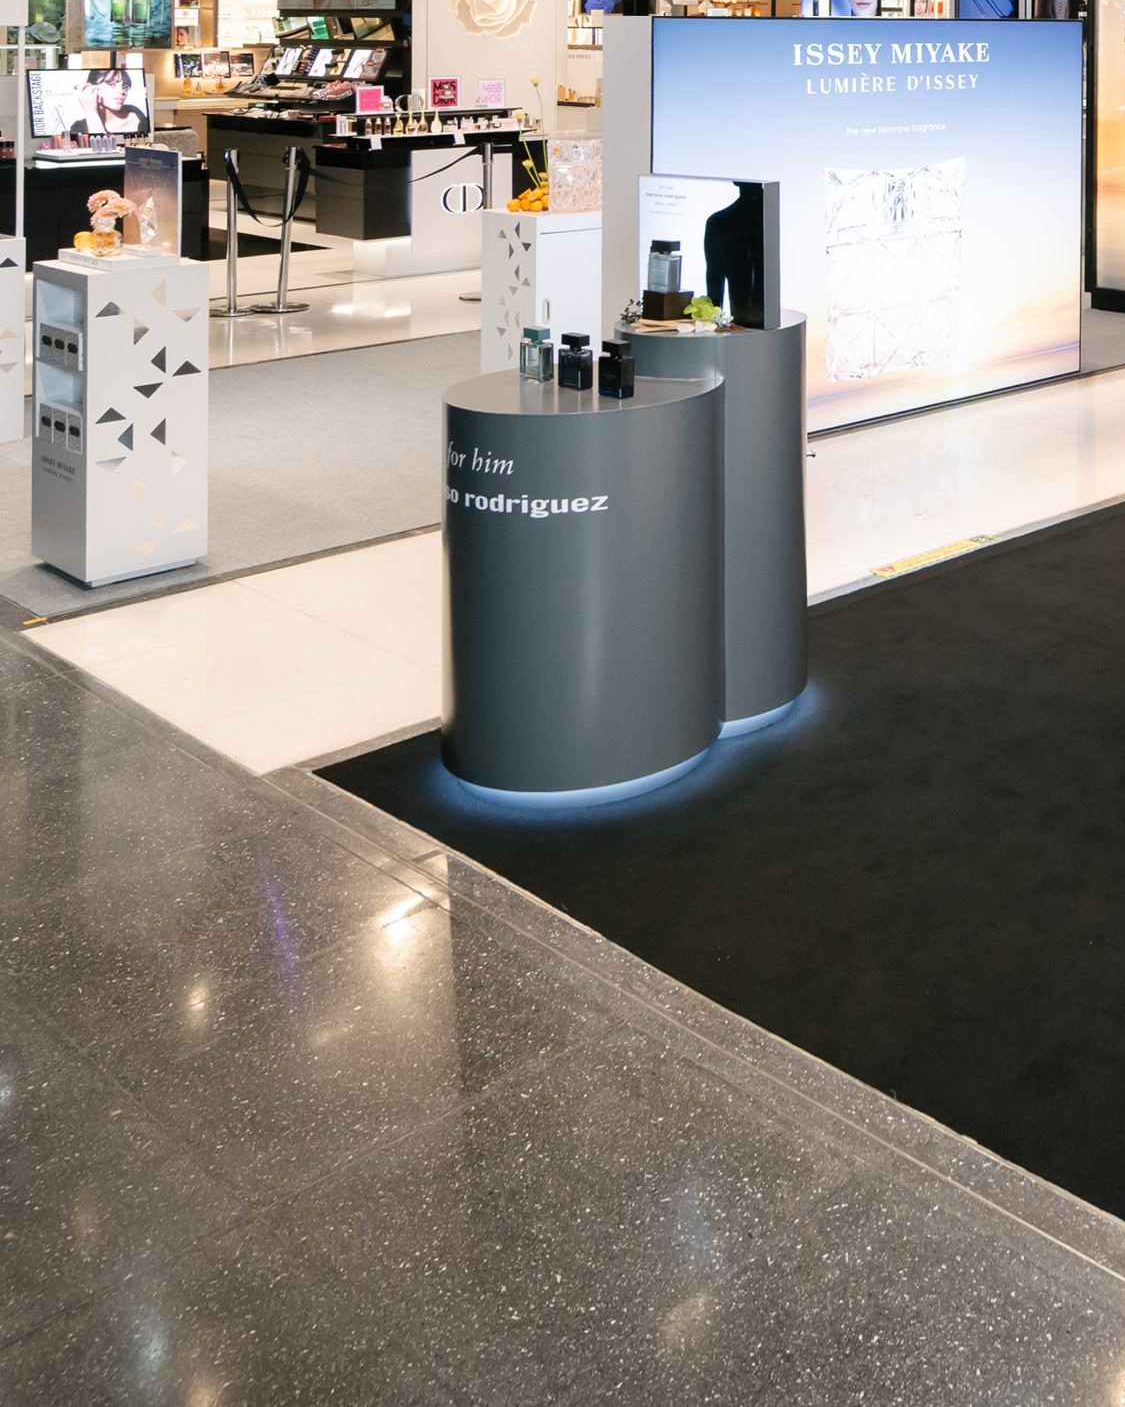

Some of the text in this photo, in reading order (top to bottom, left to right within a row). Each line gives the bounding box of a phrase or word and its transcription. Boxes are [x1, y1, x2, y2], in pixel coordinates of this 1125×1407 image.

[793, 42, 990, 66] ISSEY MIYAKE
[31, 72, 44, 115] BACKSTAGE
[807, 72, 979, 95] LUMIÈRE D'ISSEY
[846, 123, 946, 136] the new feminine fragrance
[446, 441, 515, 475] for him
[465, 494, 609, 518] rodriguez
